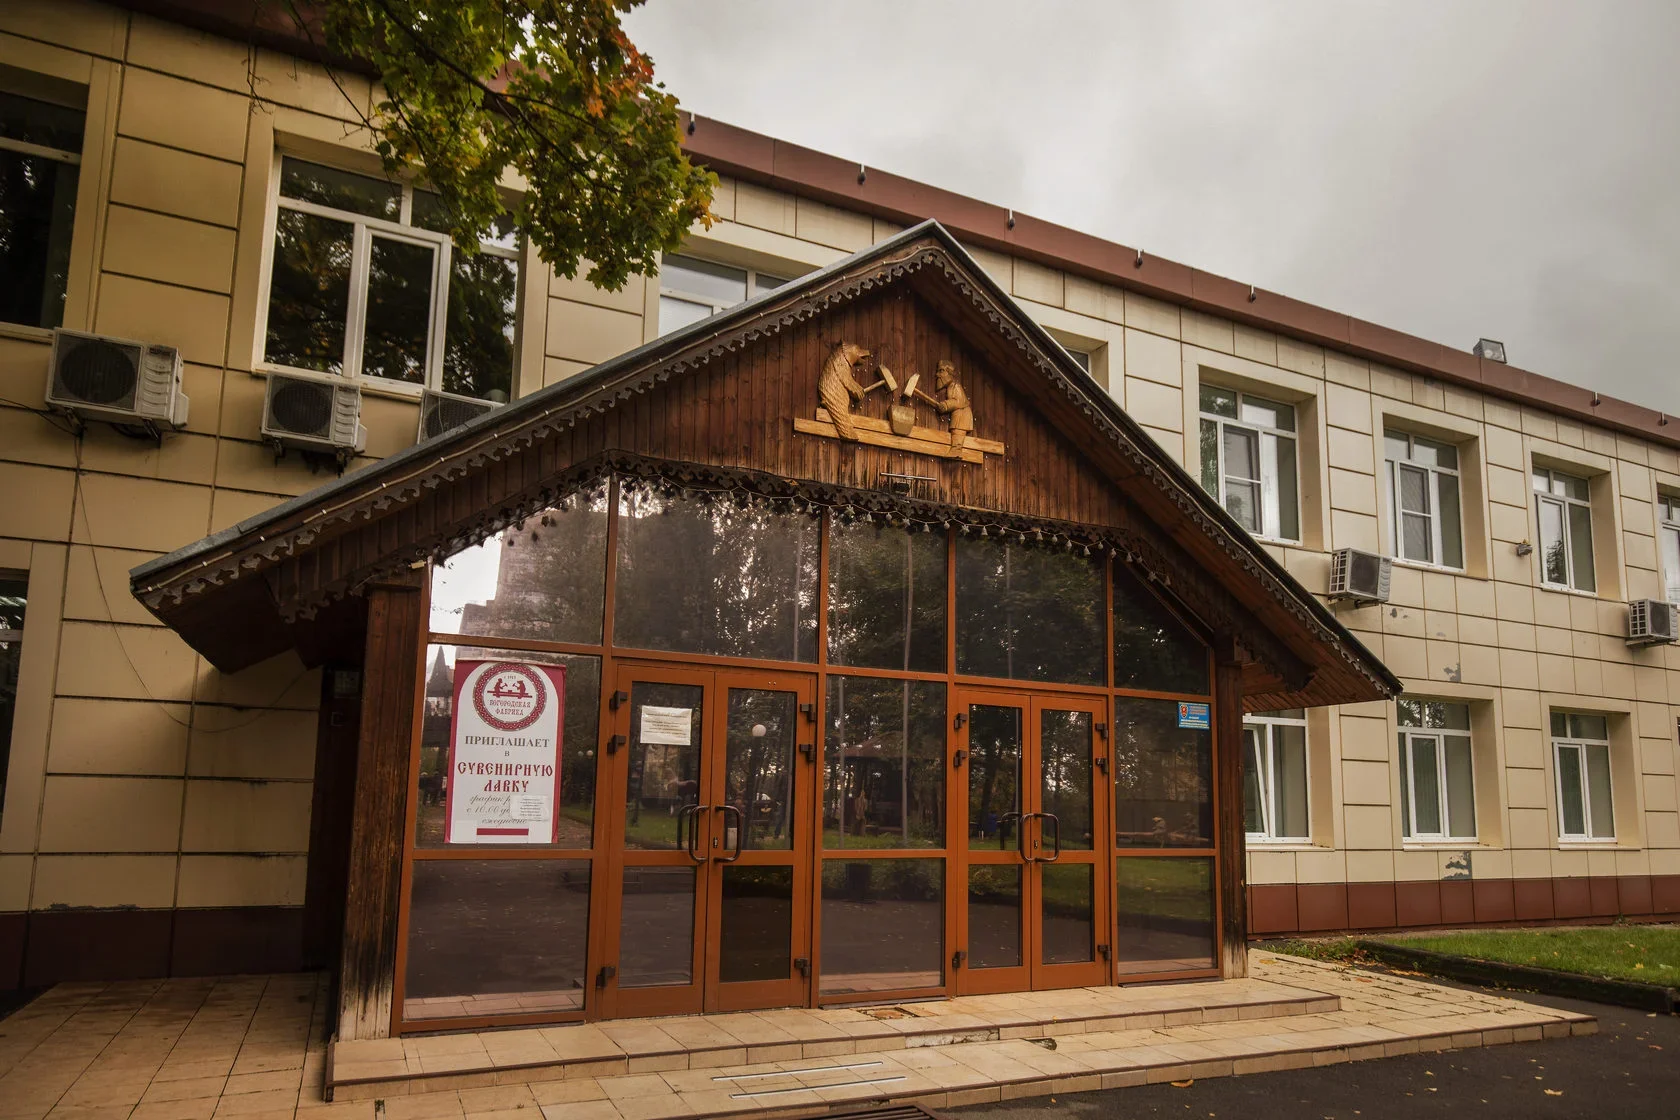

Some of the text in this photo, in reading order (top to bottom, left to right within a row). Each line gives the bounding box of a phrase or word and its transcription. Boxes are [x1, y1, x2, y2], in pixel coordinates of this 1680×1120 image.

[495, 708, 524, 716] ФАБРИКА
[465, 735, 550, 748] ПРИГЛАШАЕТ
[457, 761, 553, 777] СУВЕНИРНУЮ
[484, 779, 529, 793] ЛАВКУ
